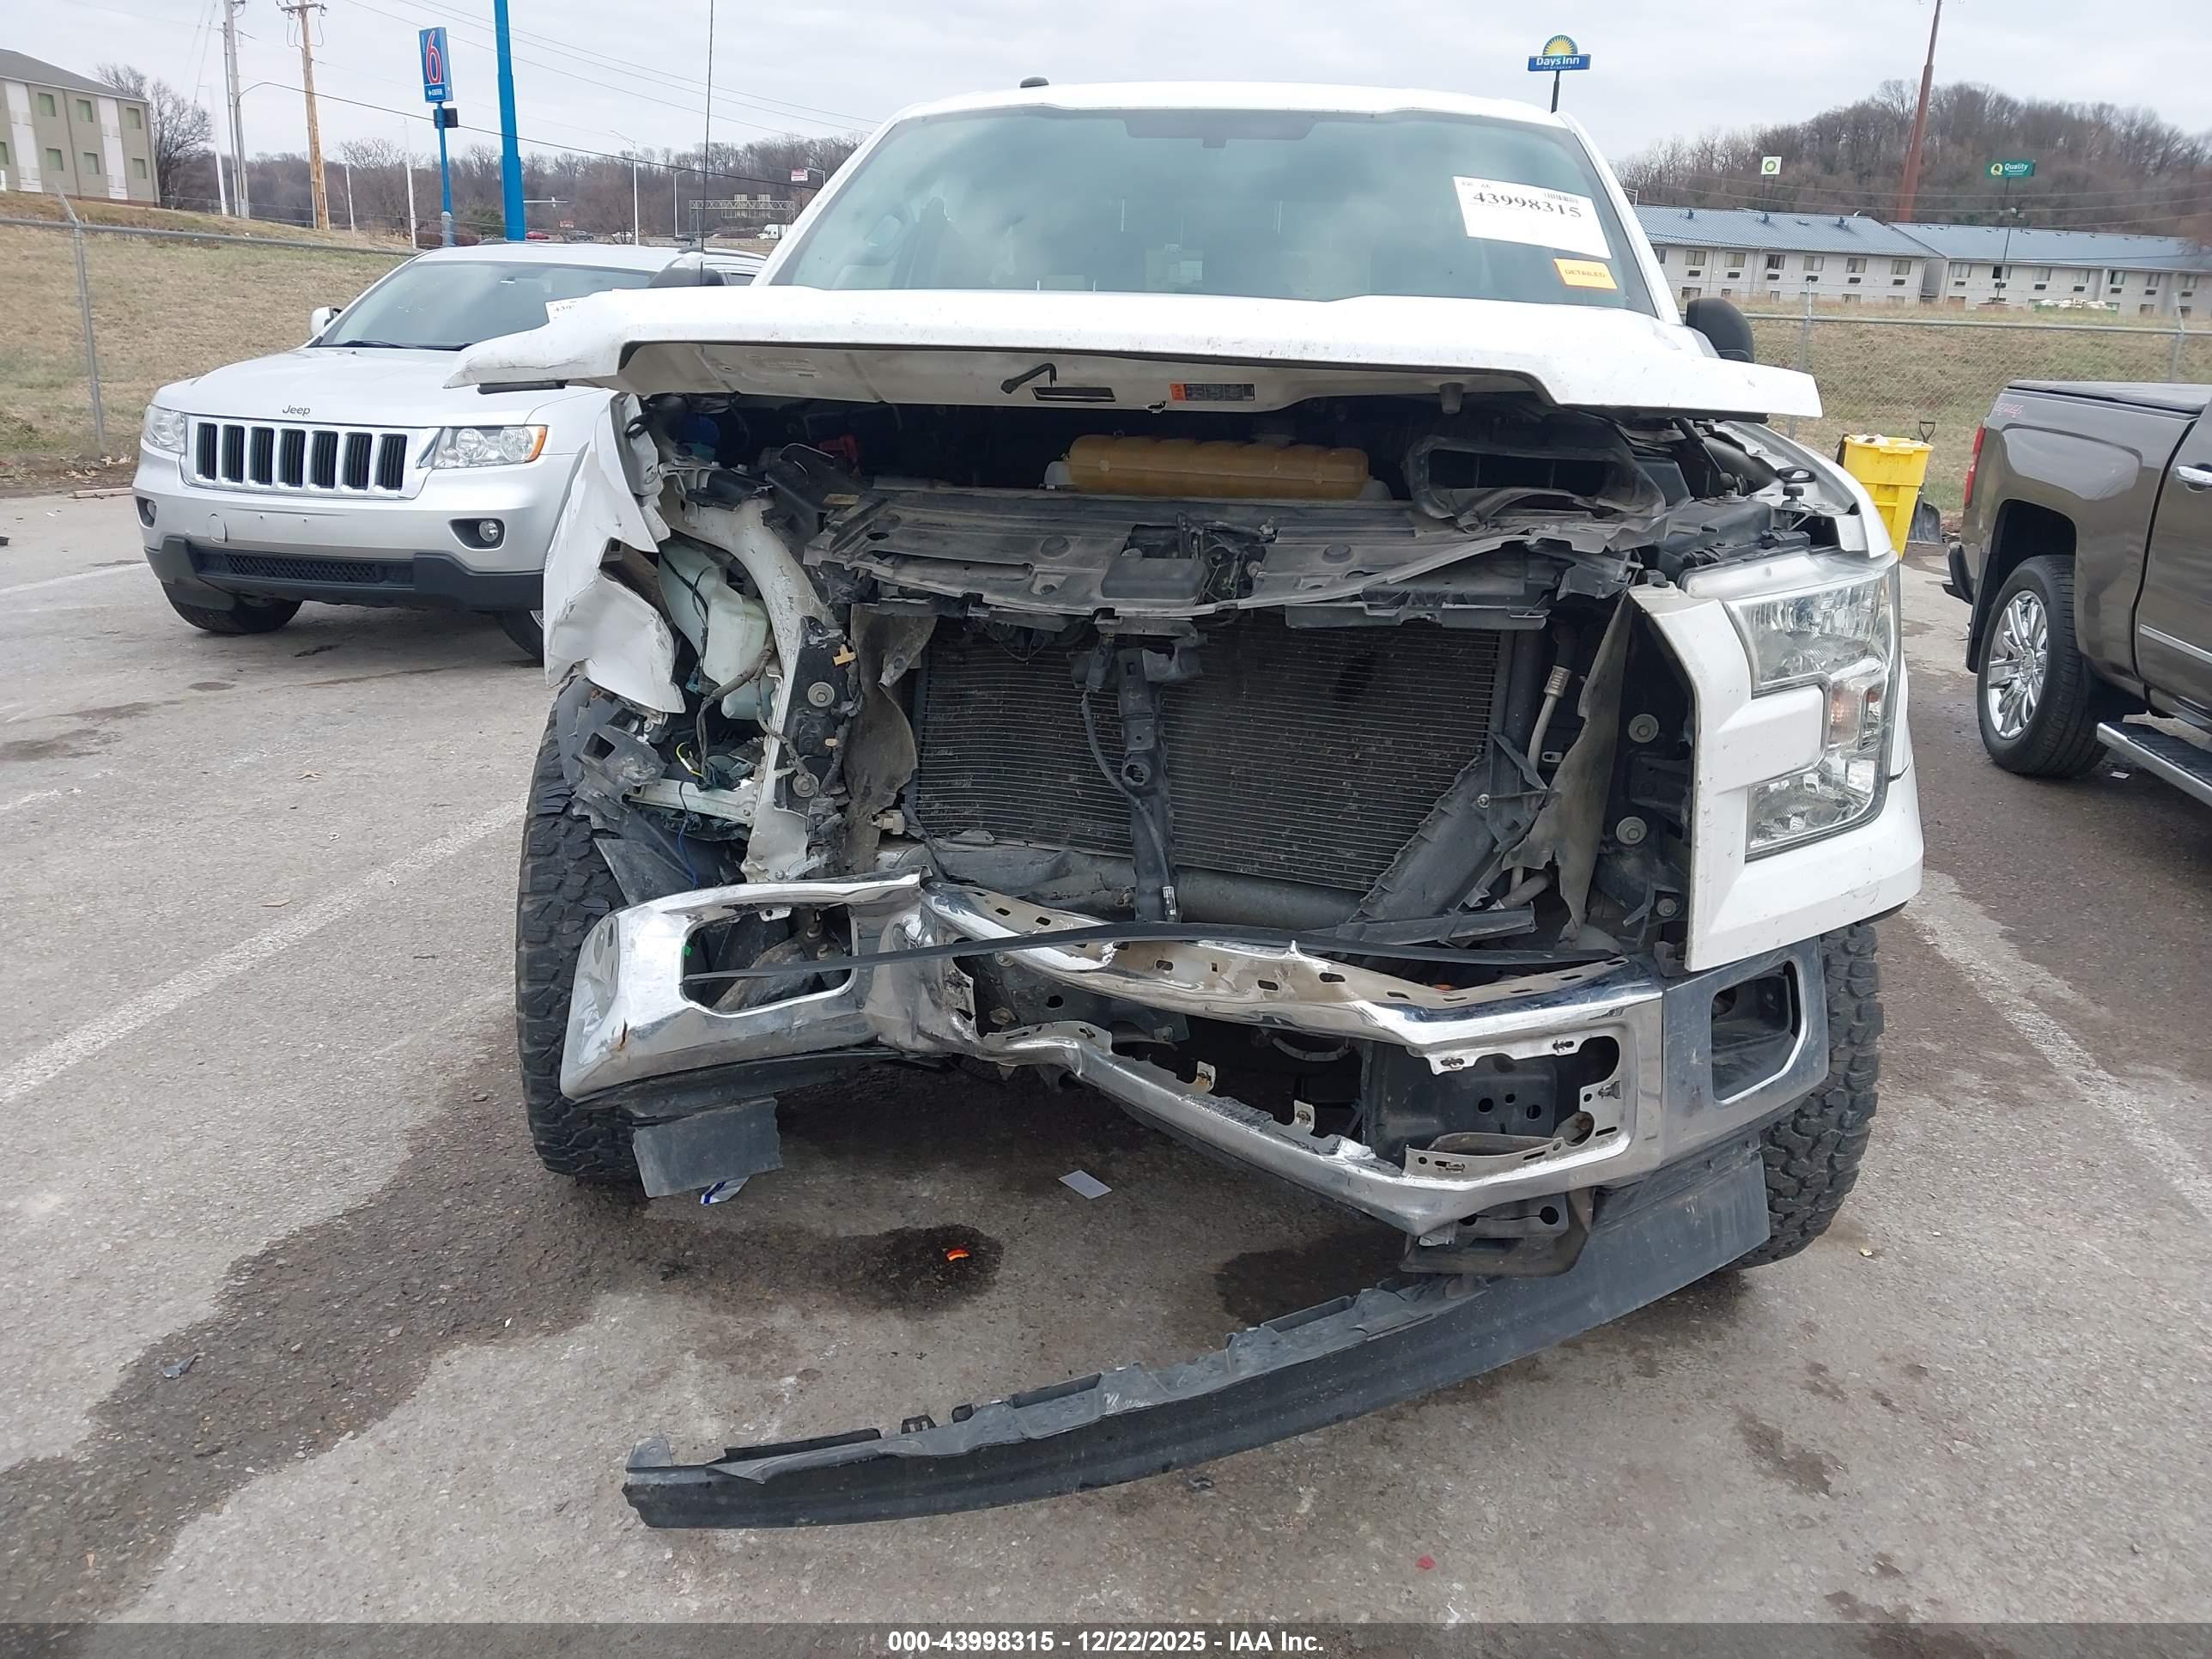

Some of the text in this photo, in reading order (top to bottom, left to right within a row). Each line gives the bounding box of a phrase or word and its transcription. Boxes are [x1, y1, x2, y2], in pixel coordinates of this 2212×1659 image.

[426, 30, 441, 84] 6
[1536, 56, 1580, 66] Days Inn
[2004, 163, 2028, 172] Quality
[1473, 183, 1582, 218] 43998315
[1565, 269, 1607, 278] DETAILED
[283, 404, 311, 416] Jeep
